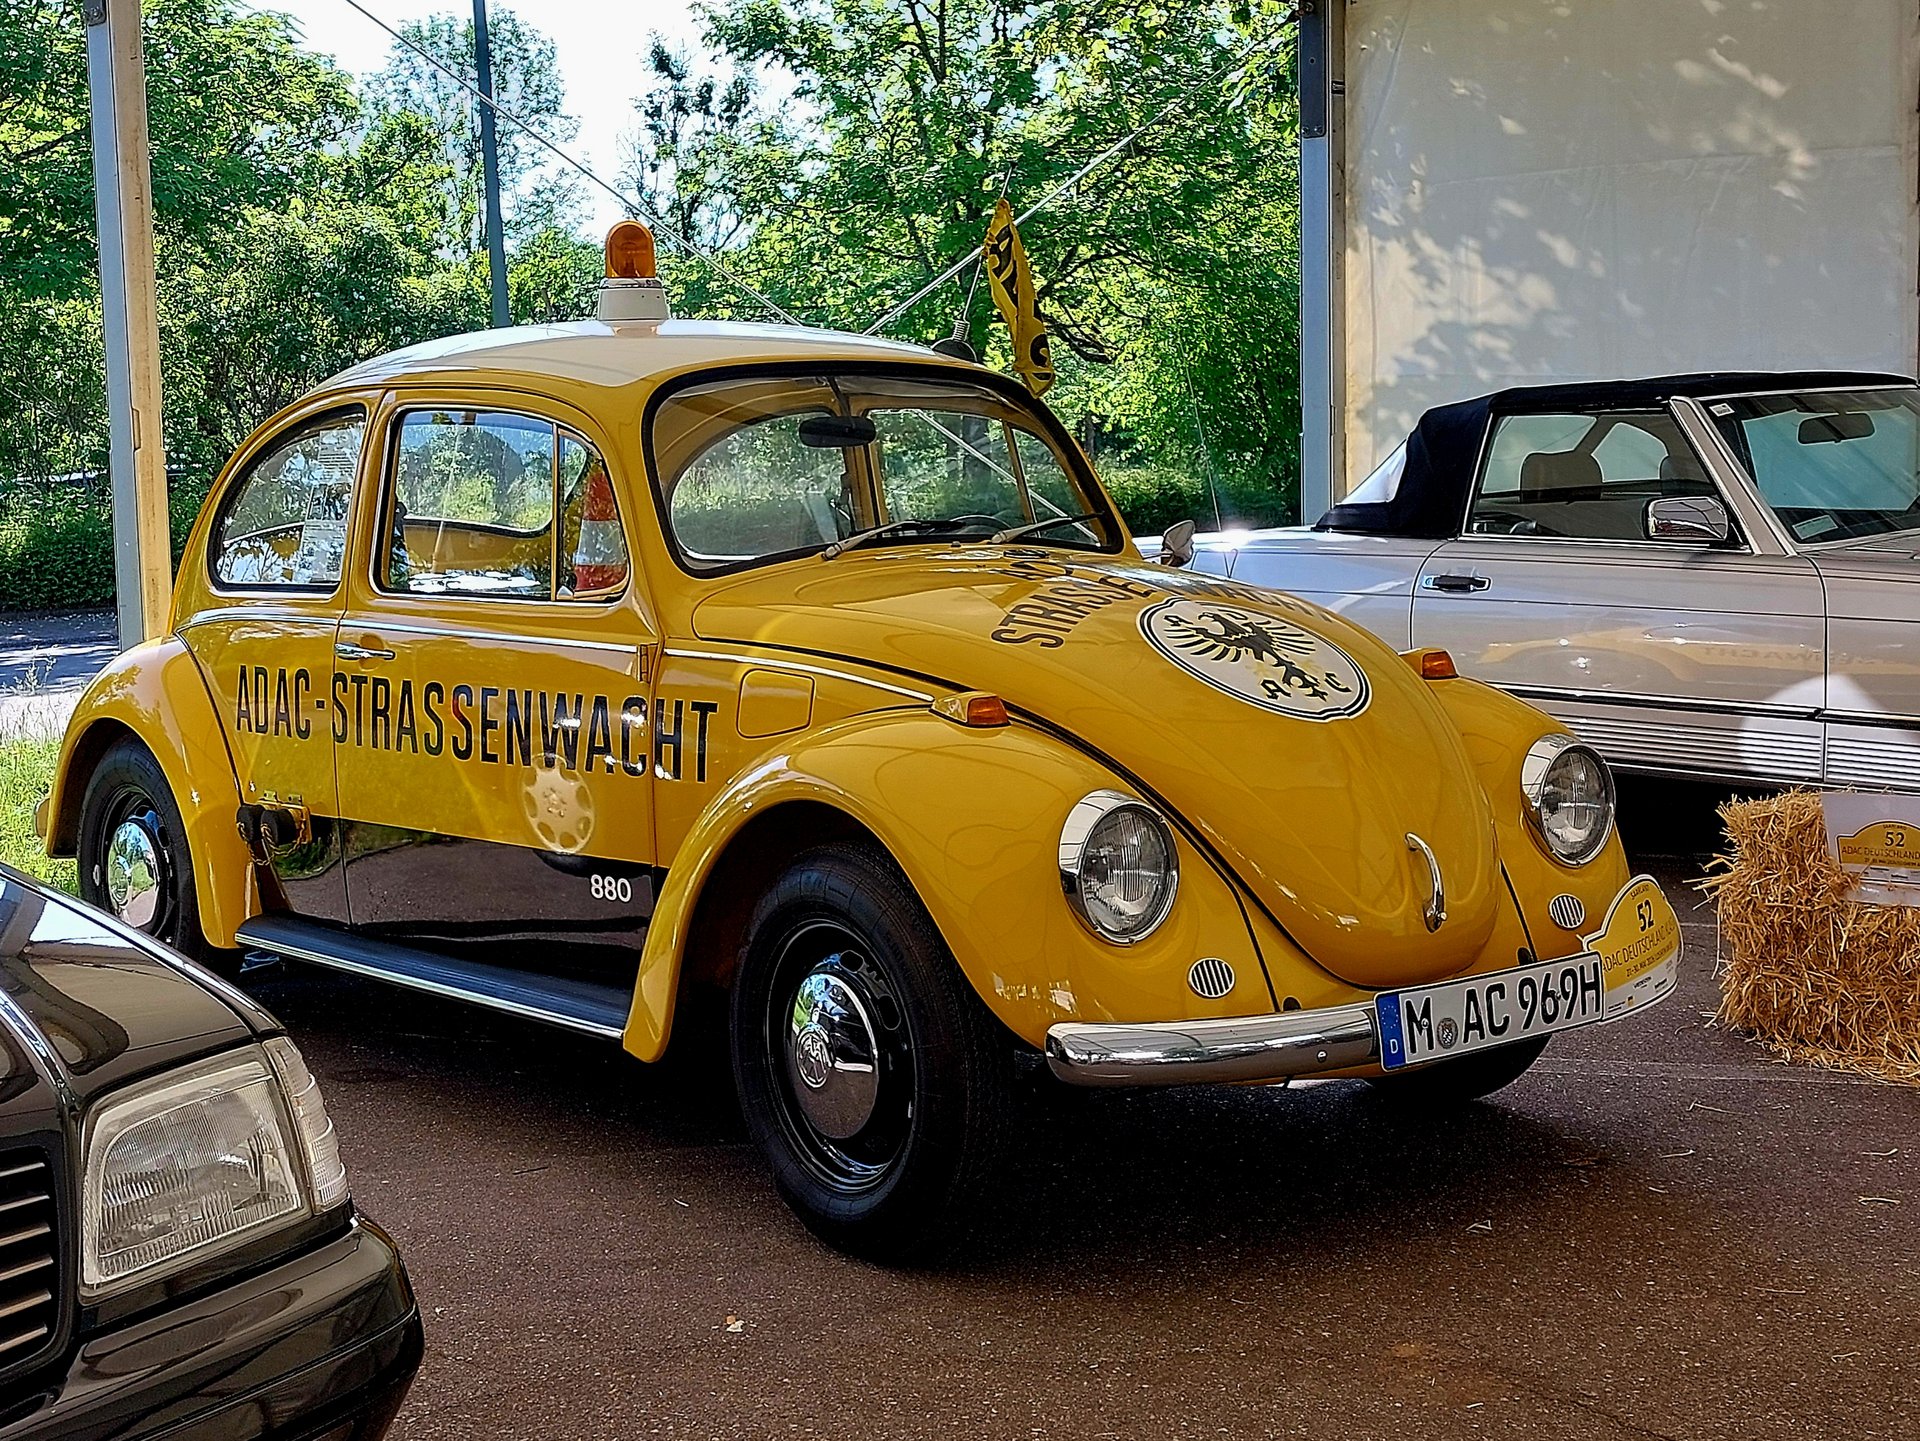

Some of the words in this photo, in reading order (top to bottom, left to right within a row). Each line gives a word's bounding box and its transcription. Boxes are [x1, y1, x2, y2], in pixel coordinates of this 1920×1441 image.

[236, 664, 719, 783] ADAC-STRASSENWACHT
[1842, 846, 1863, 854] ADAC
[1885, 832, 1905, 847] 52
[591, 874, 631, 902] 880
[1637, 900, 1655, 932] 52
[1405, 996, 1435, 1054] M
[1463, 983, 1510, 1043] AC
[1518, 962, 1600, 1031] 969H
[1390, 1039, 1398, 1054] D
